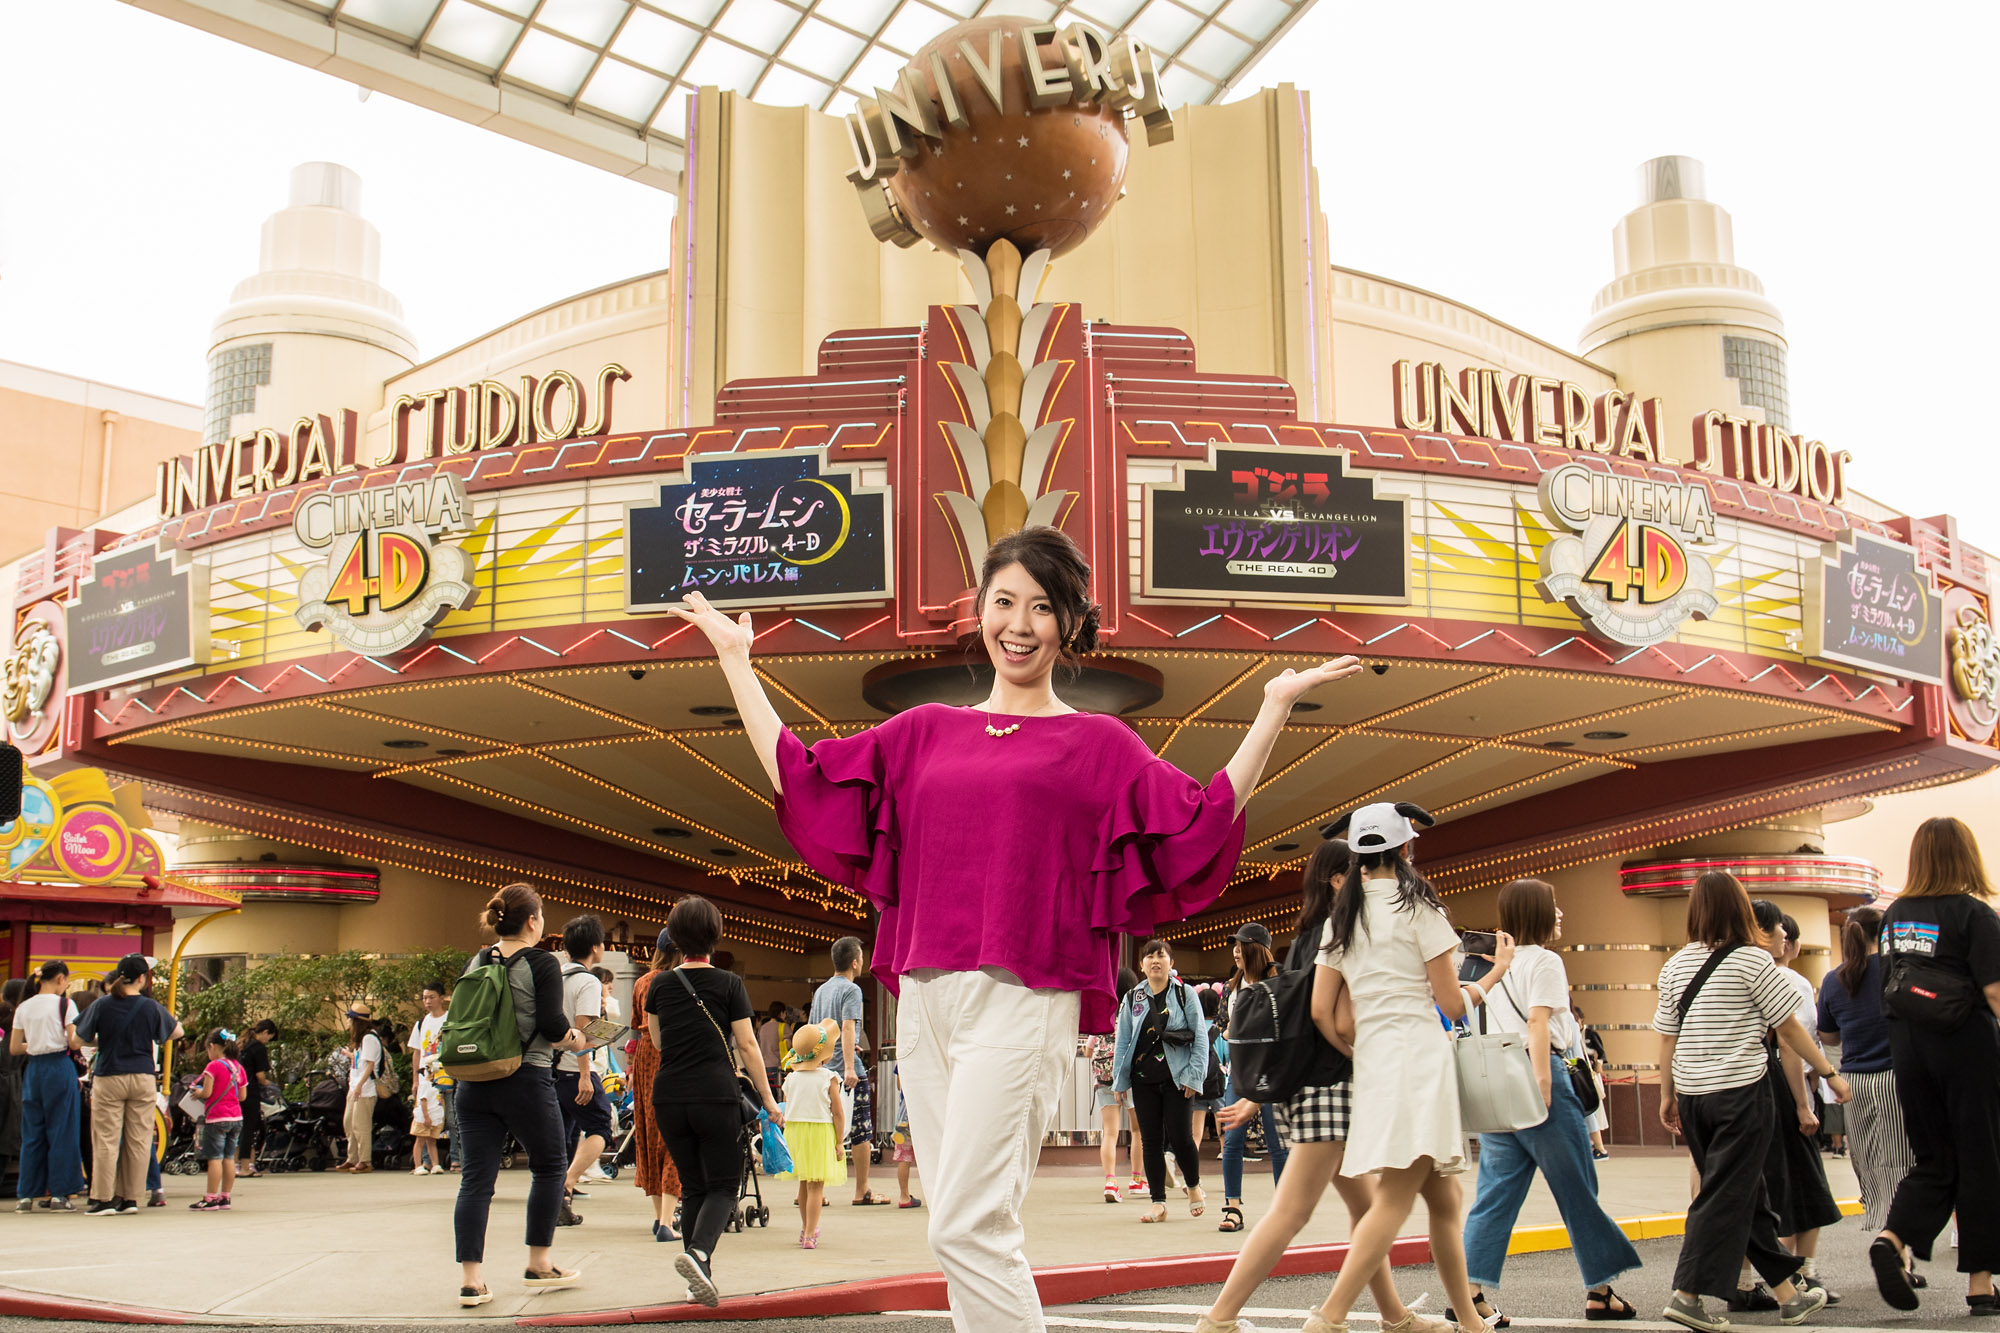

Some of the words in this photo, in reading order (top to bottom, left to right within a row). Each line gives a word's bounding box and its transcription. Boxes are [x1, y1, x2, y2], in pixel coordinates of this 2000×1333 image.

[156, 408, 362, 521] UNIVERSAL
[375, 363, 629, 467] STUDIOS
[1395, 358, 1681, 467] UNIVERSAL
[1692, 409, 1853, 506] STUDIOS
[1231, 467, 1331, 507] ゴジラ
[1551, 464, 1715, 537] CINEMA
[294, 474, 462, 549] CINEMA
[675, 486, 825, 534] セーラームーン
[1185, 507, 1260, 517] GODZILLA
[1270, 509, 1294, 521] VS
[1304, 512, 1377, 522] EVANGELION
[1200, 519, 1362, 563] エヴァンゲリオン
[1236, 563, 1263, 572] THE
[1268, 565, 1303, 574] REAL
[1308, 566, 1327, 574] 4D
[65, 843, 96, 855] Moon
[1883, 938, 1932, 953] pagonia
